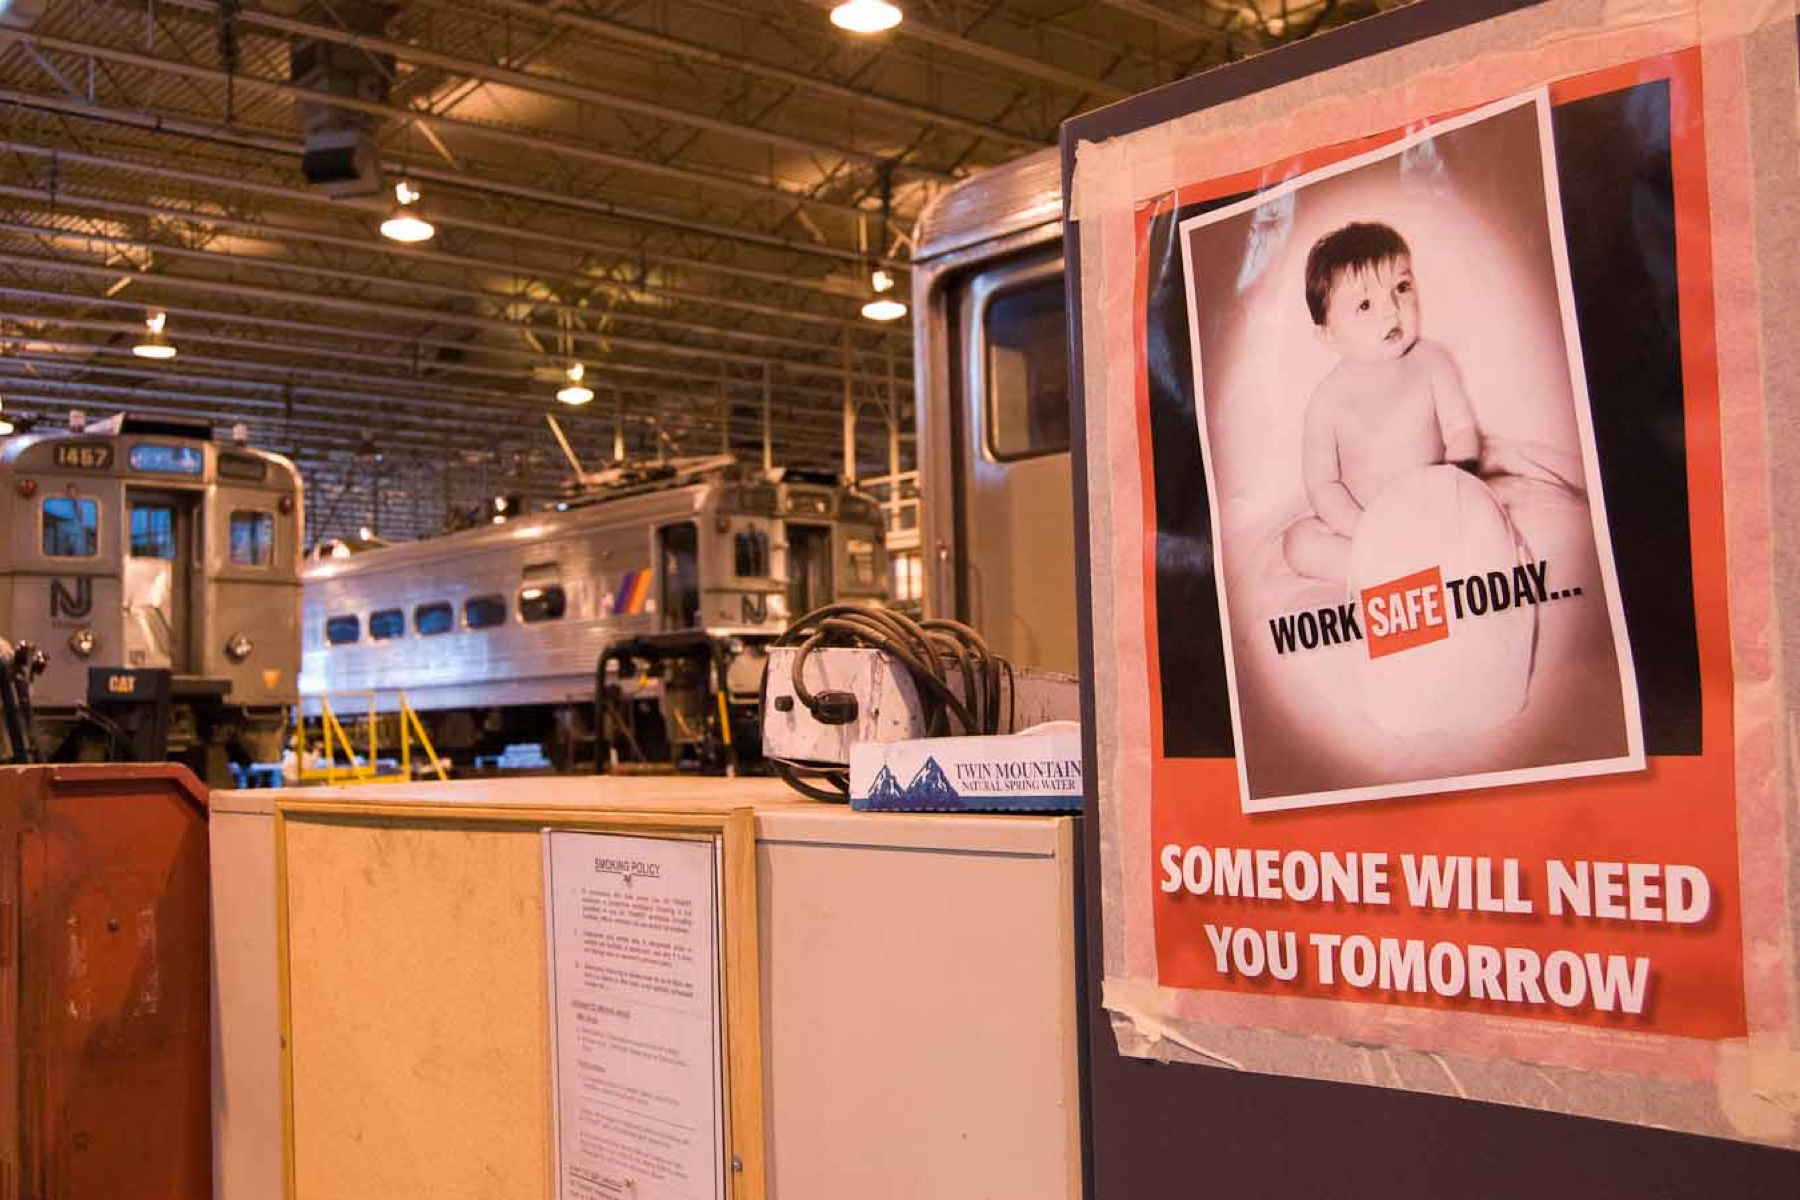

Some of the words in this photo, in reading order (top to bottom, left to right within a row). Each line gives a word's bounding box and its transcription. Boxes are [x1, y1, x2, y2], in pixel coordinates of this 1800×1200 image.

[1269, 603, 1363, 654] WORK
[1368, 584, 1443, 637] SAFE
[1446, 560, 1583, 619] TODAY...
[109, 676, 136, 692] CAT
[955, 762, 992, 779] TWIN
[994, 760, 1082, 778] MOUNTAIN
[962, 780, 1000, 791] NATURAL
[1005, 780, 1039, 791] SPRING
[1041, 778, 1076, 790] WATER
[594, 857, 630, 872] SMOKING
[631, 862, 661, 875] POLICY
[1160, 844, 1390, 905] SOMEONE
[1401, 854, 1532, 913] WILL
[1546, 860, 1711, 924] NEED
[1204, 923, 1298, 980] YOU
[1309, 933, 1650, 1014] TOMORROW
